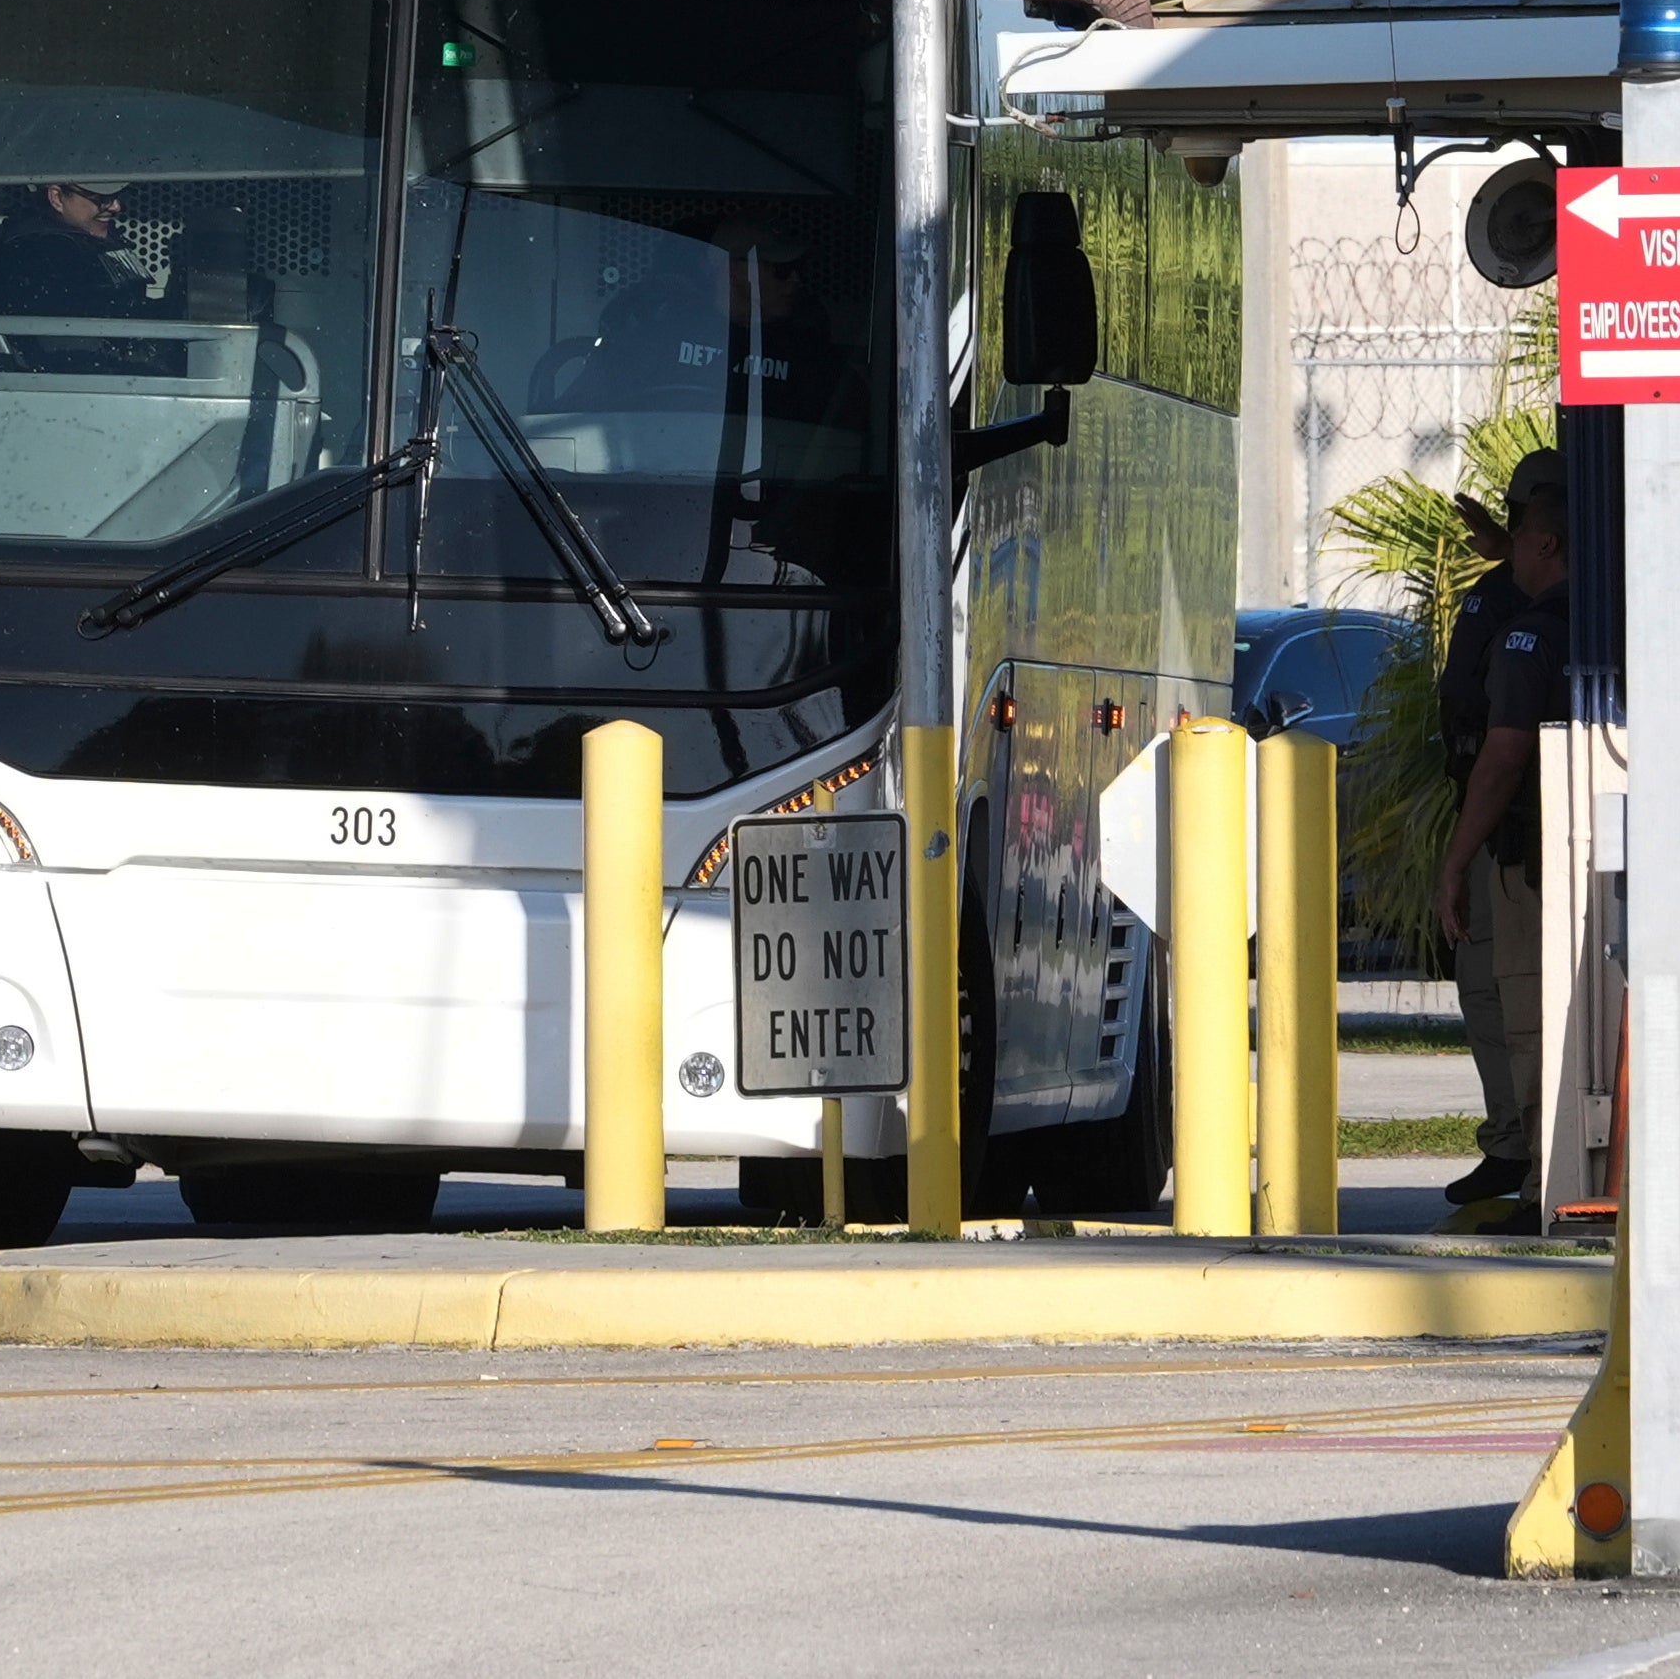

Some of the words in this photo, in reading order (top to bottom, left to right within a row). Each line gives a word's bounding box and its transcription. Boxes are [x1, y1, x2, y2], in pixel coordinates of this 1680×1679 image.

[330, 806, 396, 847] 303
[743, 853, 810, 906] ONE
[827, 850, 897, 902] WAY
[753, 931, 797, 982] DO
[823, 928, 890, 980] NOT
[769, 1007, 876, 1060] ENTER
